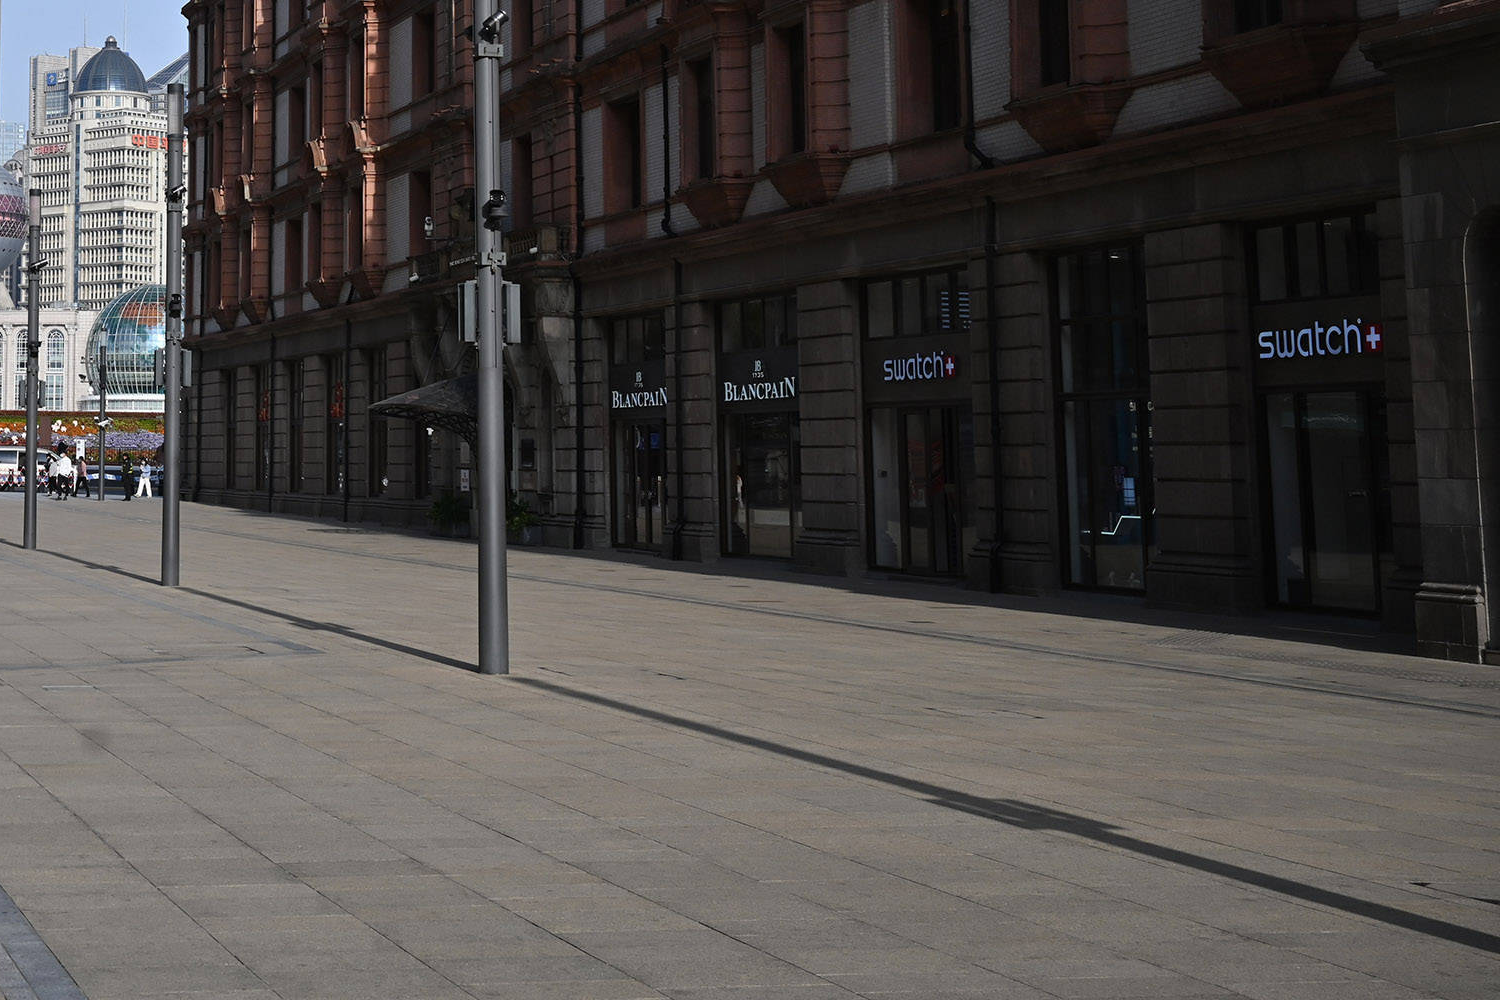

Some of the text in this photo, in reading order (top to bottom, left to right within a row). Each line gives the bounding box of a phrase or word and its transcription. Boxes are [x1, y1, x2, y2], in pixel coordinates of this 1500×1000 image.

[1258, 318, 1362, 359] swatch
[883, 350, 944, 381] swatch
[611, 387, 668, 409] BLANCPAIN
[723, 376, 796, 402] BLANCPAIN
